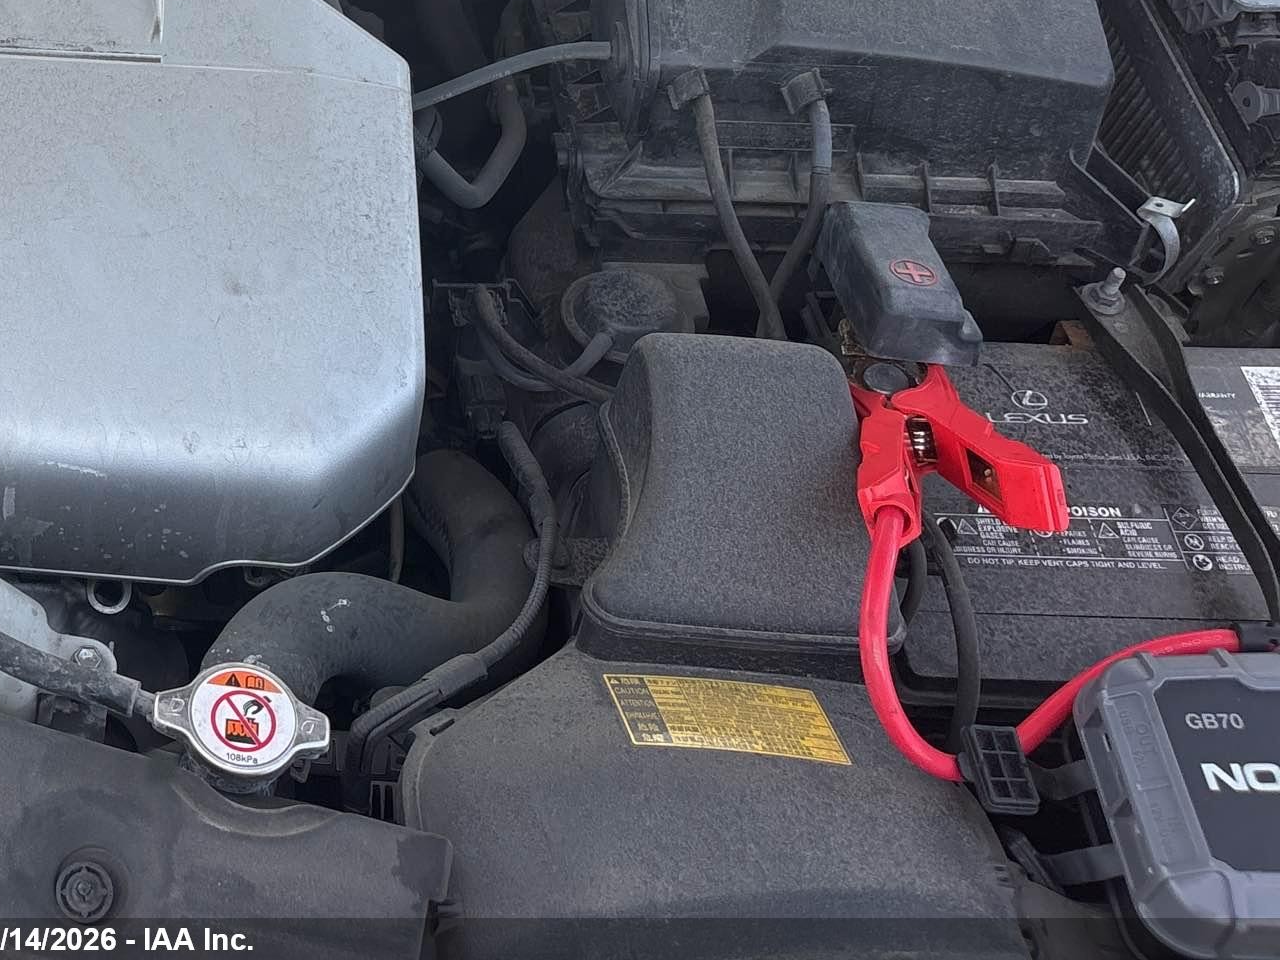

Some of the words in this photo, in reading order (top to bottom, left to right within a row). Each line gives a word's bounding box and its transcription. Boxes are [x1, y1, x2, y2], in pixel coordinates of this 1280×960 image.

[985, 412, 1088, 425] LEXUS
[1067, 506, 1121, 517] OISON
[1018, 558, 1040, 566] KEEP
[1066, 560, 1089, 568] CAPS
[614, 687, 650, 695] CAUTION
[1185, 712, 1245, 730] GB70
[226, 752, 258, 764] 108kPa
